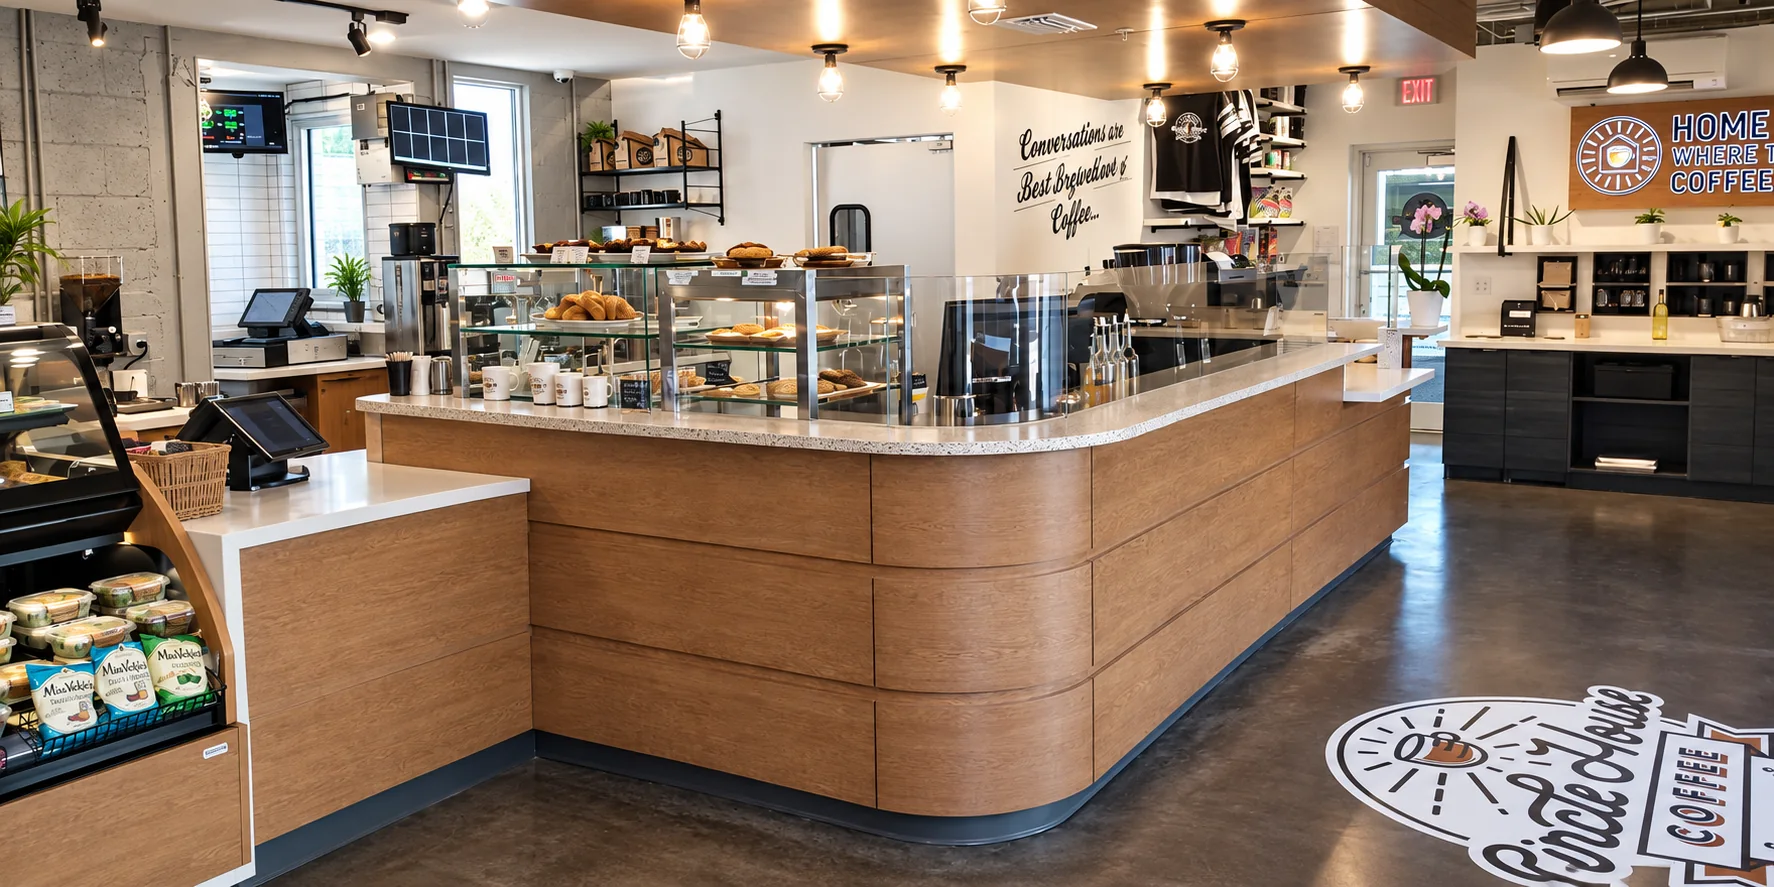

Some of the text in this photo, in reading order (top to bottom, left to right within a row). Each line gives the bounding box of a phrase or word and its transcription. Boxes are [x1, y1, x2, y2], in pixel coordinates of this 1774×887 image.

[1402, 78, 1435, 104] EXIT
[1019, 121, 1124, 161] Conversations are
[1672, 109, 1770, 142] HOME
[1671, 143, 1758, 167] WHERE
[1017, 171, 1053, 203] Best
[1669, 168, 1774, 194] COFFEE
[1526, 688, 1653, 784] House
[1666, 746, 1728, 848] COFFEE
